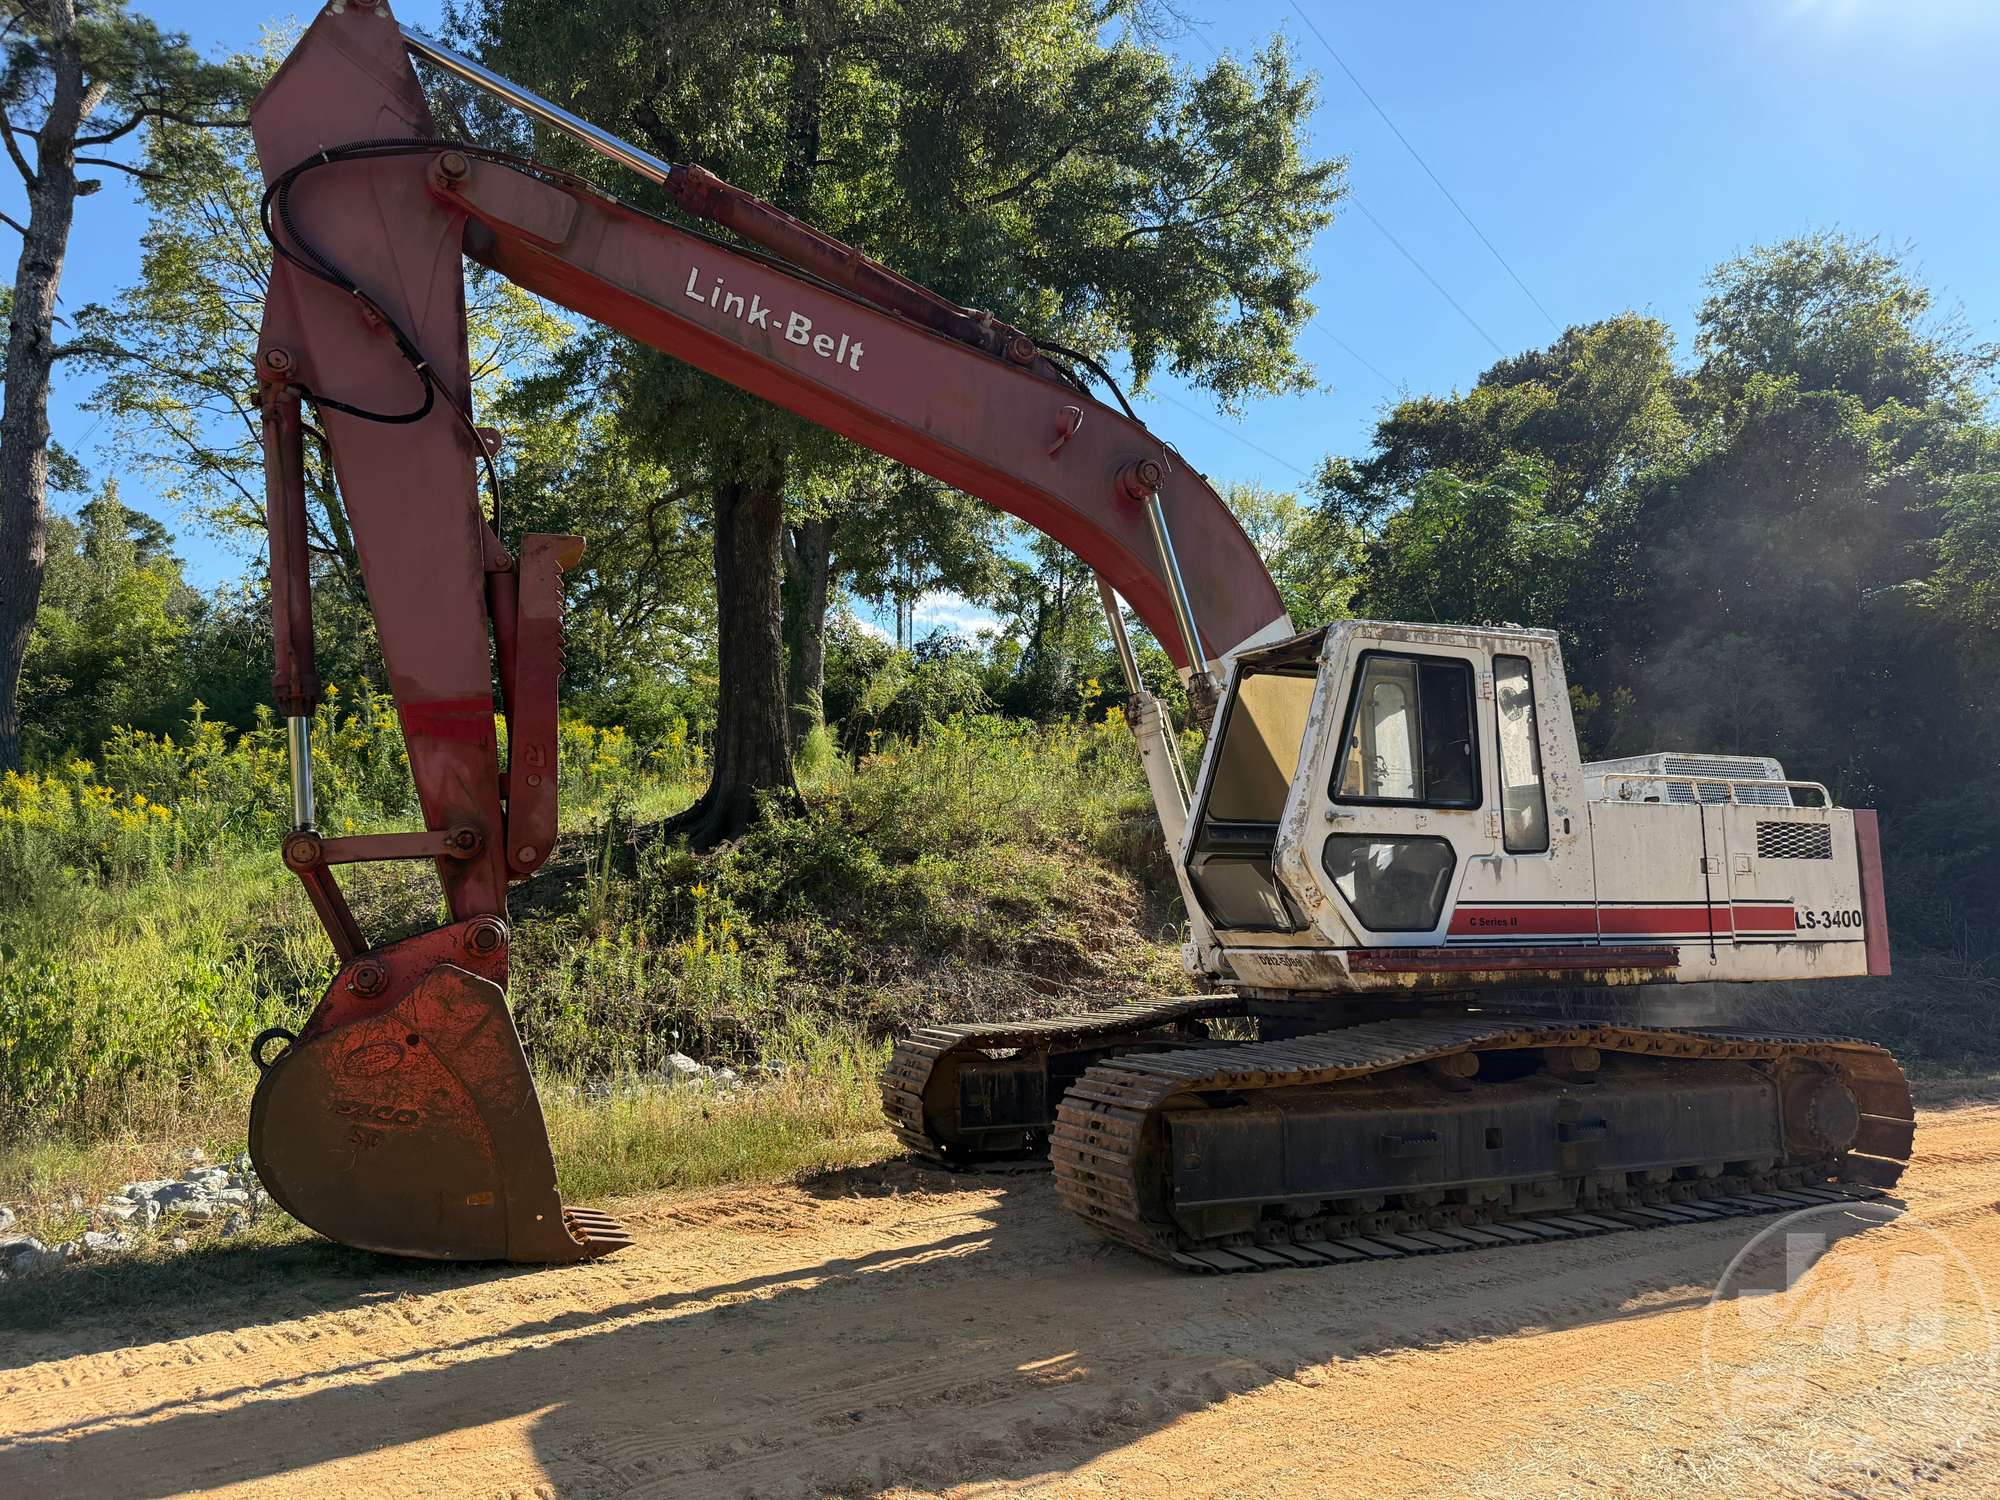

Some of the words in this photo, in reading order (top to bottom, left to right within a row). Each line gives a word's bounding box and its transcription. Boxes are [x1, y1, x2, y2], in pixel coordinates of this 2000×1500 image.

[684, 265, 865, 373] Link-Belt
[1469, 916, 1477, 927] C
[1479, 915, 1508, 927] Series
[1794, 909, 1862, 930] LS-3400
